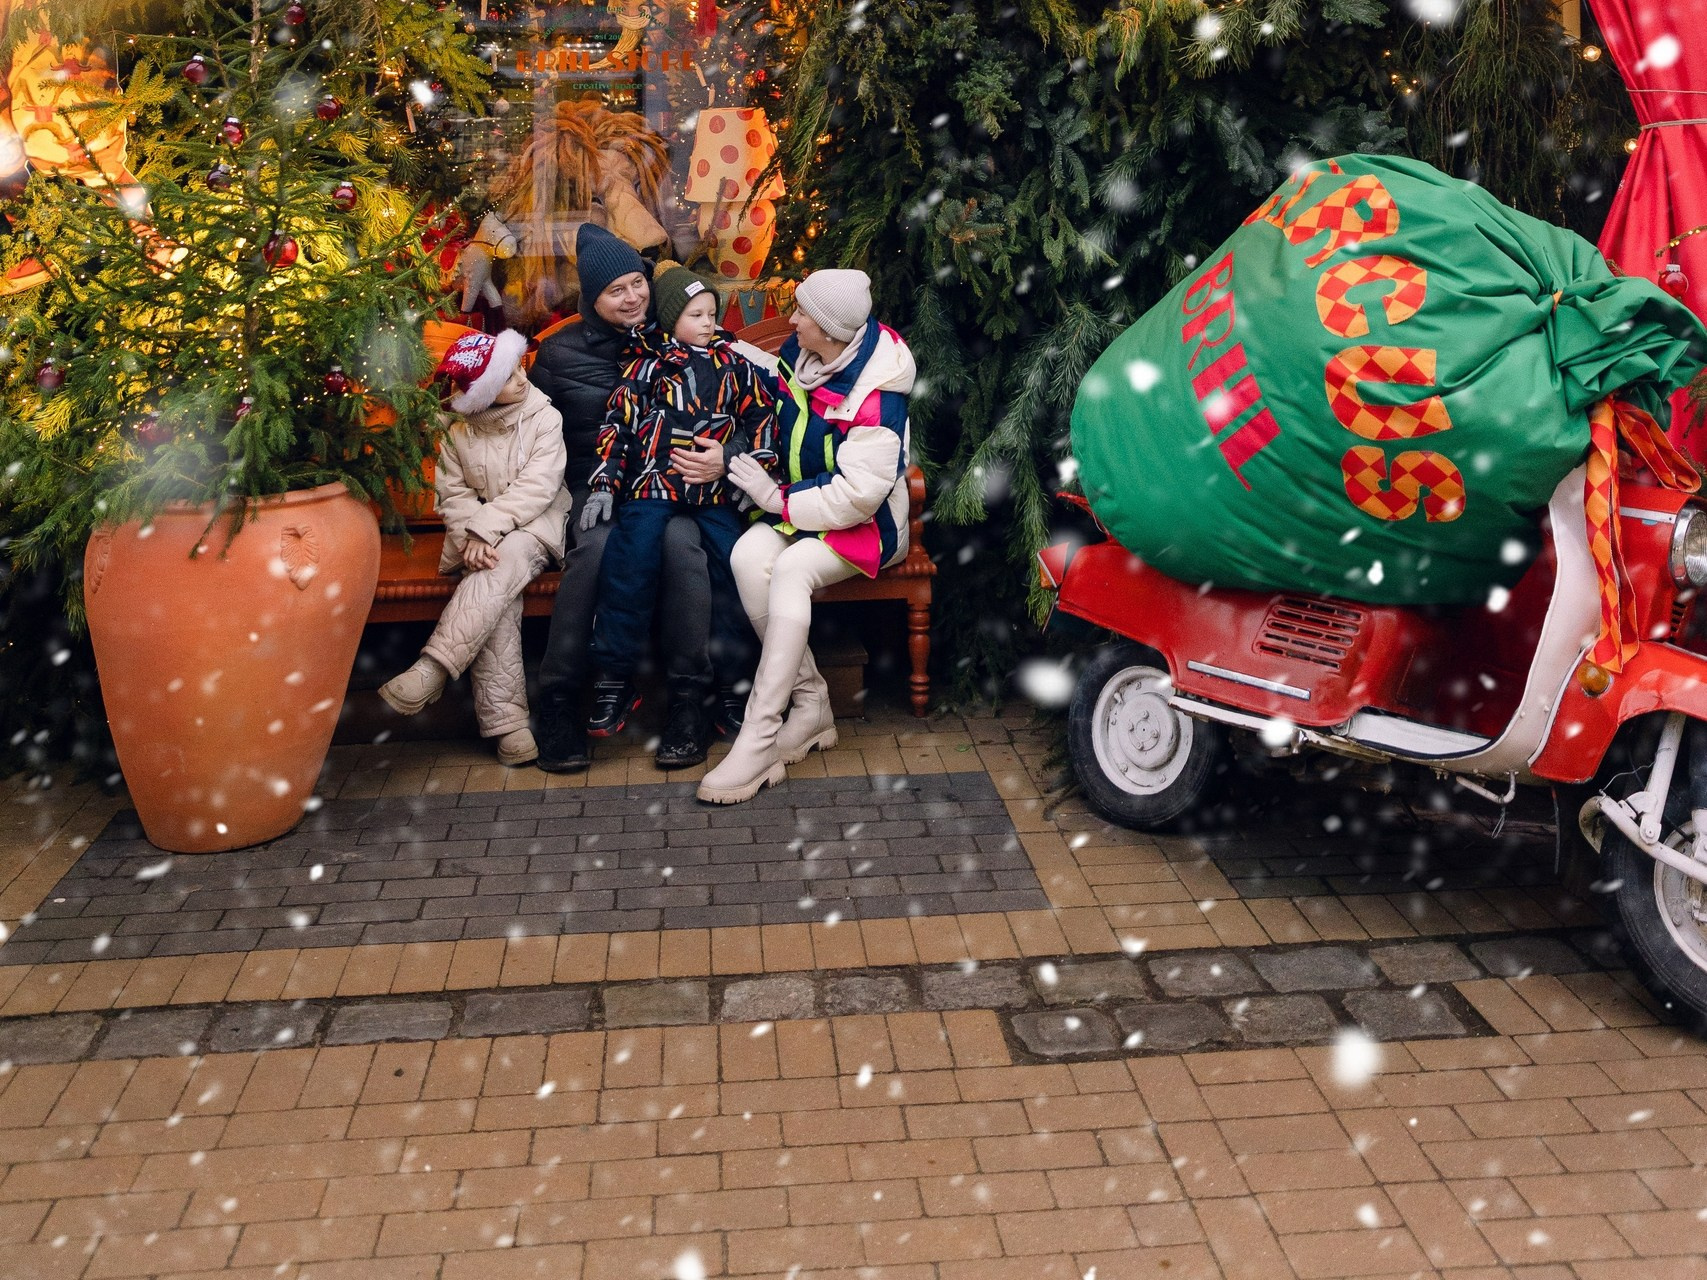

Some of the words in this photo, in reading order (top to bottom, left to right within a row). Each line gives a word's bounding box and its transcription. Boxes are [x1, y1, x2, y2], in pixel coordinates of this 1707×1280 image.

[607, 49, 696, 73] STORE
[572, 82, 612, 90] creative
[615, 83, 643, 92] space
